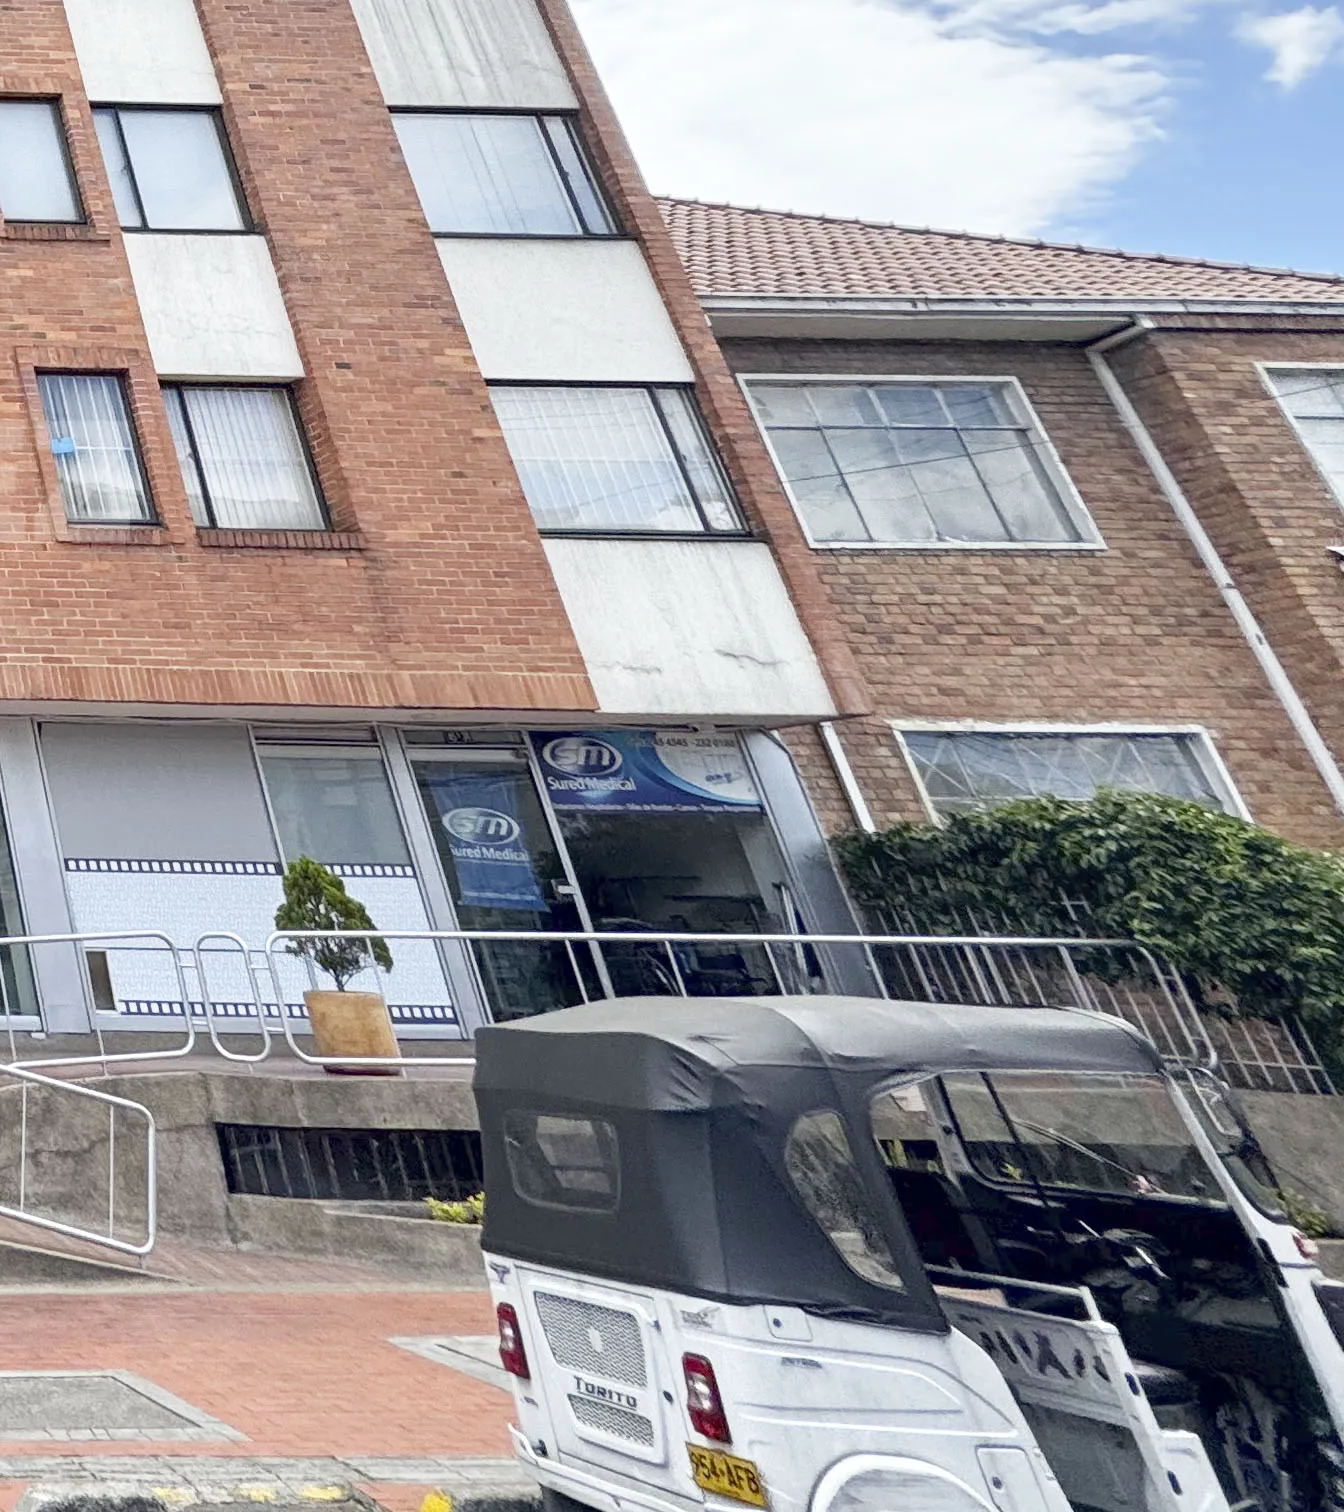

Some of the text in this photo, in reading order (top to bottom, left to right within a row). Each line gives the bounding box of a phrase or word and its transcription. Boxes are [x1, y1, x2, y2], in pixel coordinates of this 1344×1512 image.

[547, 776, 637, 791] Sured Medical
[482, 846, 530, 862] Medical
[574, 1376, 638, 1409] TORITO
